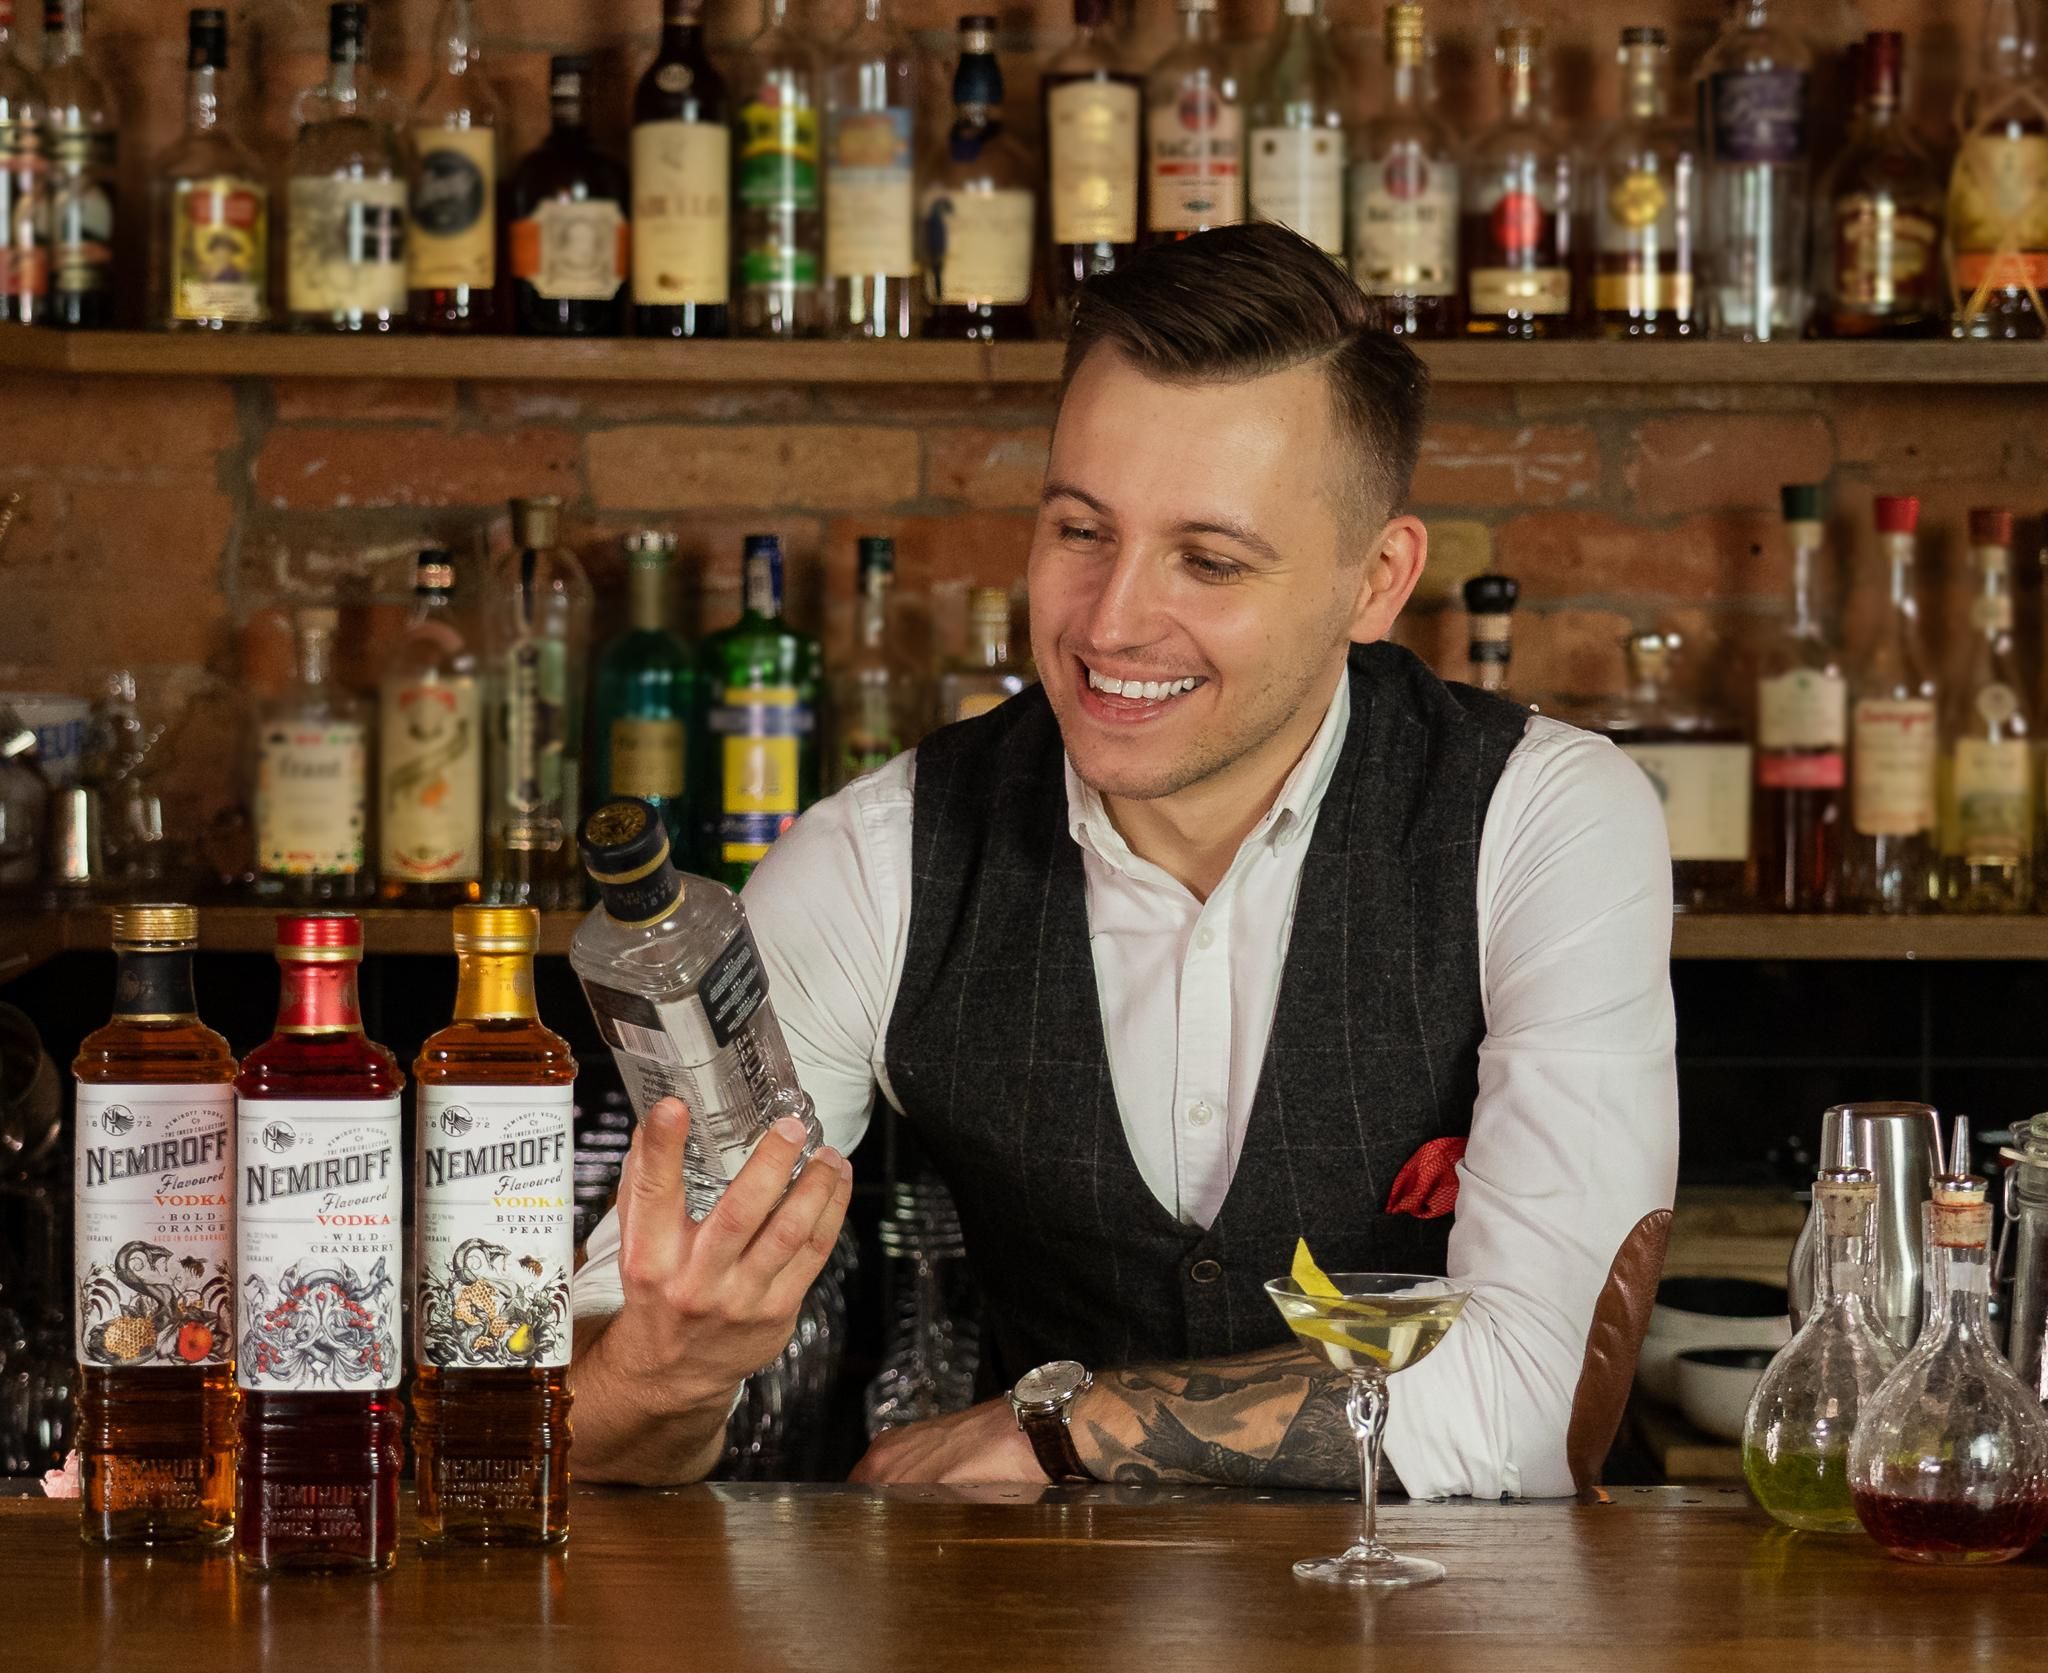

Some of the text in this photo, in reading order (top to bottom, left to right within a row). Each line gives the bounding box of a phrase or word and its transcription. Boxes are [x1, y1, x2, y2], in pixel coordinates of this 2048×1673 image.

[86, 1128, 229, 1188] NEMIROFF
[424, 1129, 566, 1188] NEMIROFF
[156, 1166, 226, 1195] Flavoured
[246, 1145, 392, 1206] NEMIROFF
[494, 1168, 563, 1195] Flavoured
[153, 1194, 228, 1206] VODKA
[318, 1185, 390, 1214] Flavoured
[492, 1196, 565, 1208] VODKA
[169, 1212, 217, 1221] BOLD
[316, 1213, 391, 1226] VODKA
[496, 1214, 564, 1222] BURNING
[157, 1223, 227, 1233] ORANGE
[509, 1226, 552, 1234] PEAR
[333, 1232, 379, 1241] WILD
